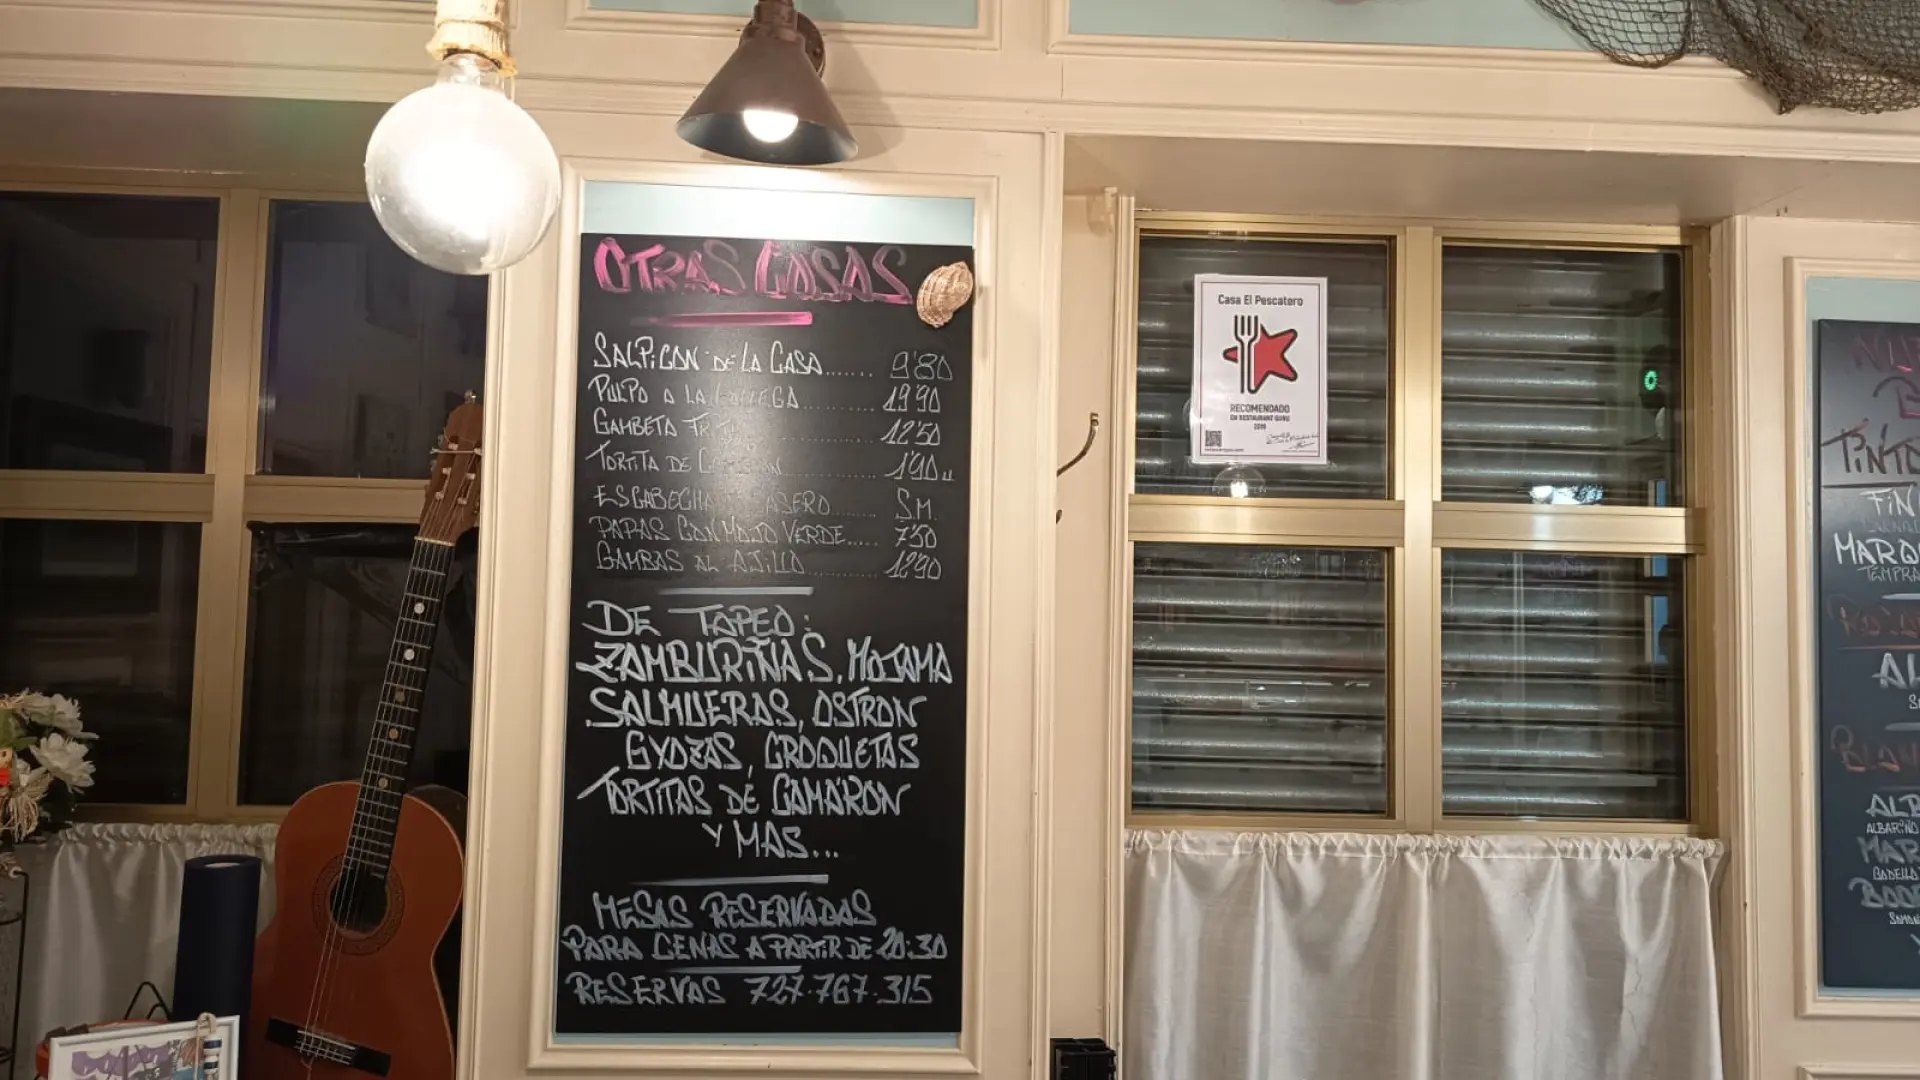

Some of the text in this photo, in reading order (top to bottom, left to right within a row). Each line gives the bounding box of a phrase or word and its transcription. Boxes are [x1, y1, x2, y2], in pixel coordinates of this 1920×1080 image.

[594, 237, 913, 304] OTRAS COSAS
[1218, 294, 1304, 307] Casa El Pescatero
[711, 353, 737, 372] DE
[741, 341, 762, 374] LA
[770, 339, 824, 377] CASA
[890, 351, 953, 381] 9'80
[587, 373, 649, 403] PULPO
[664, 388, 676, 404] A
[685, 383, 707, 405] LA
[883, 382, 941, 413] 19'90
[1230, 404, 1291, 414] RECOMENDADO
[593, 407, 678, 437] GAMBETA
[880, 418, 941, 446] 12'50
[585, 440, 660, 475] TORTITA
[666, 454, 692, 473] DE
[588, 515, 672, 541] PAPAS
[677, 514, 721, 543] CON
[721, 515, 779, 544] MOJO
[781, 519, 846, 547] VERDE
[1834, 530, 1920, 566] MARQ
[595, 540, 685, 572] GAMBAS
[693, 555, 720, 573] AL
[727, 548, 806, 574] AJILLO
[582, 600, 661, 636] DE
[847, 636, 953, 685] MOJAMA
[813, 686, 927, 728] OSTRON
[764, 729, 920, 770] CROQUETAS
[577, 766, 714, 816] TORTITAS
[702, 822, 723, 847] Y
[592, 888, 877, 930] MESAS RESERVADAS
[561, 924, 644, 961] PARA
[652, 929, 740, 961] CENAS
[746, 934, 766, 960] A
[761, 933, 844, 960] PARTIR
[845, 936, 873, 960] DE
[565, 971, 726, 1005] RESERVAS
